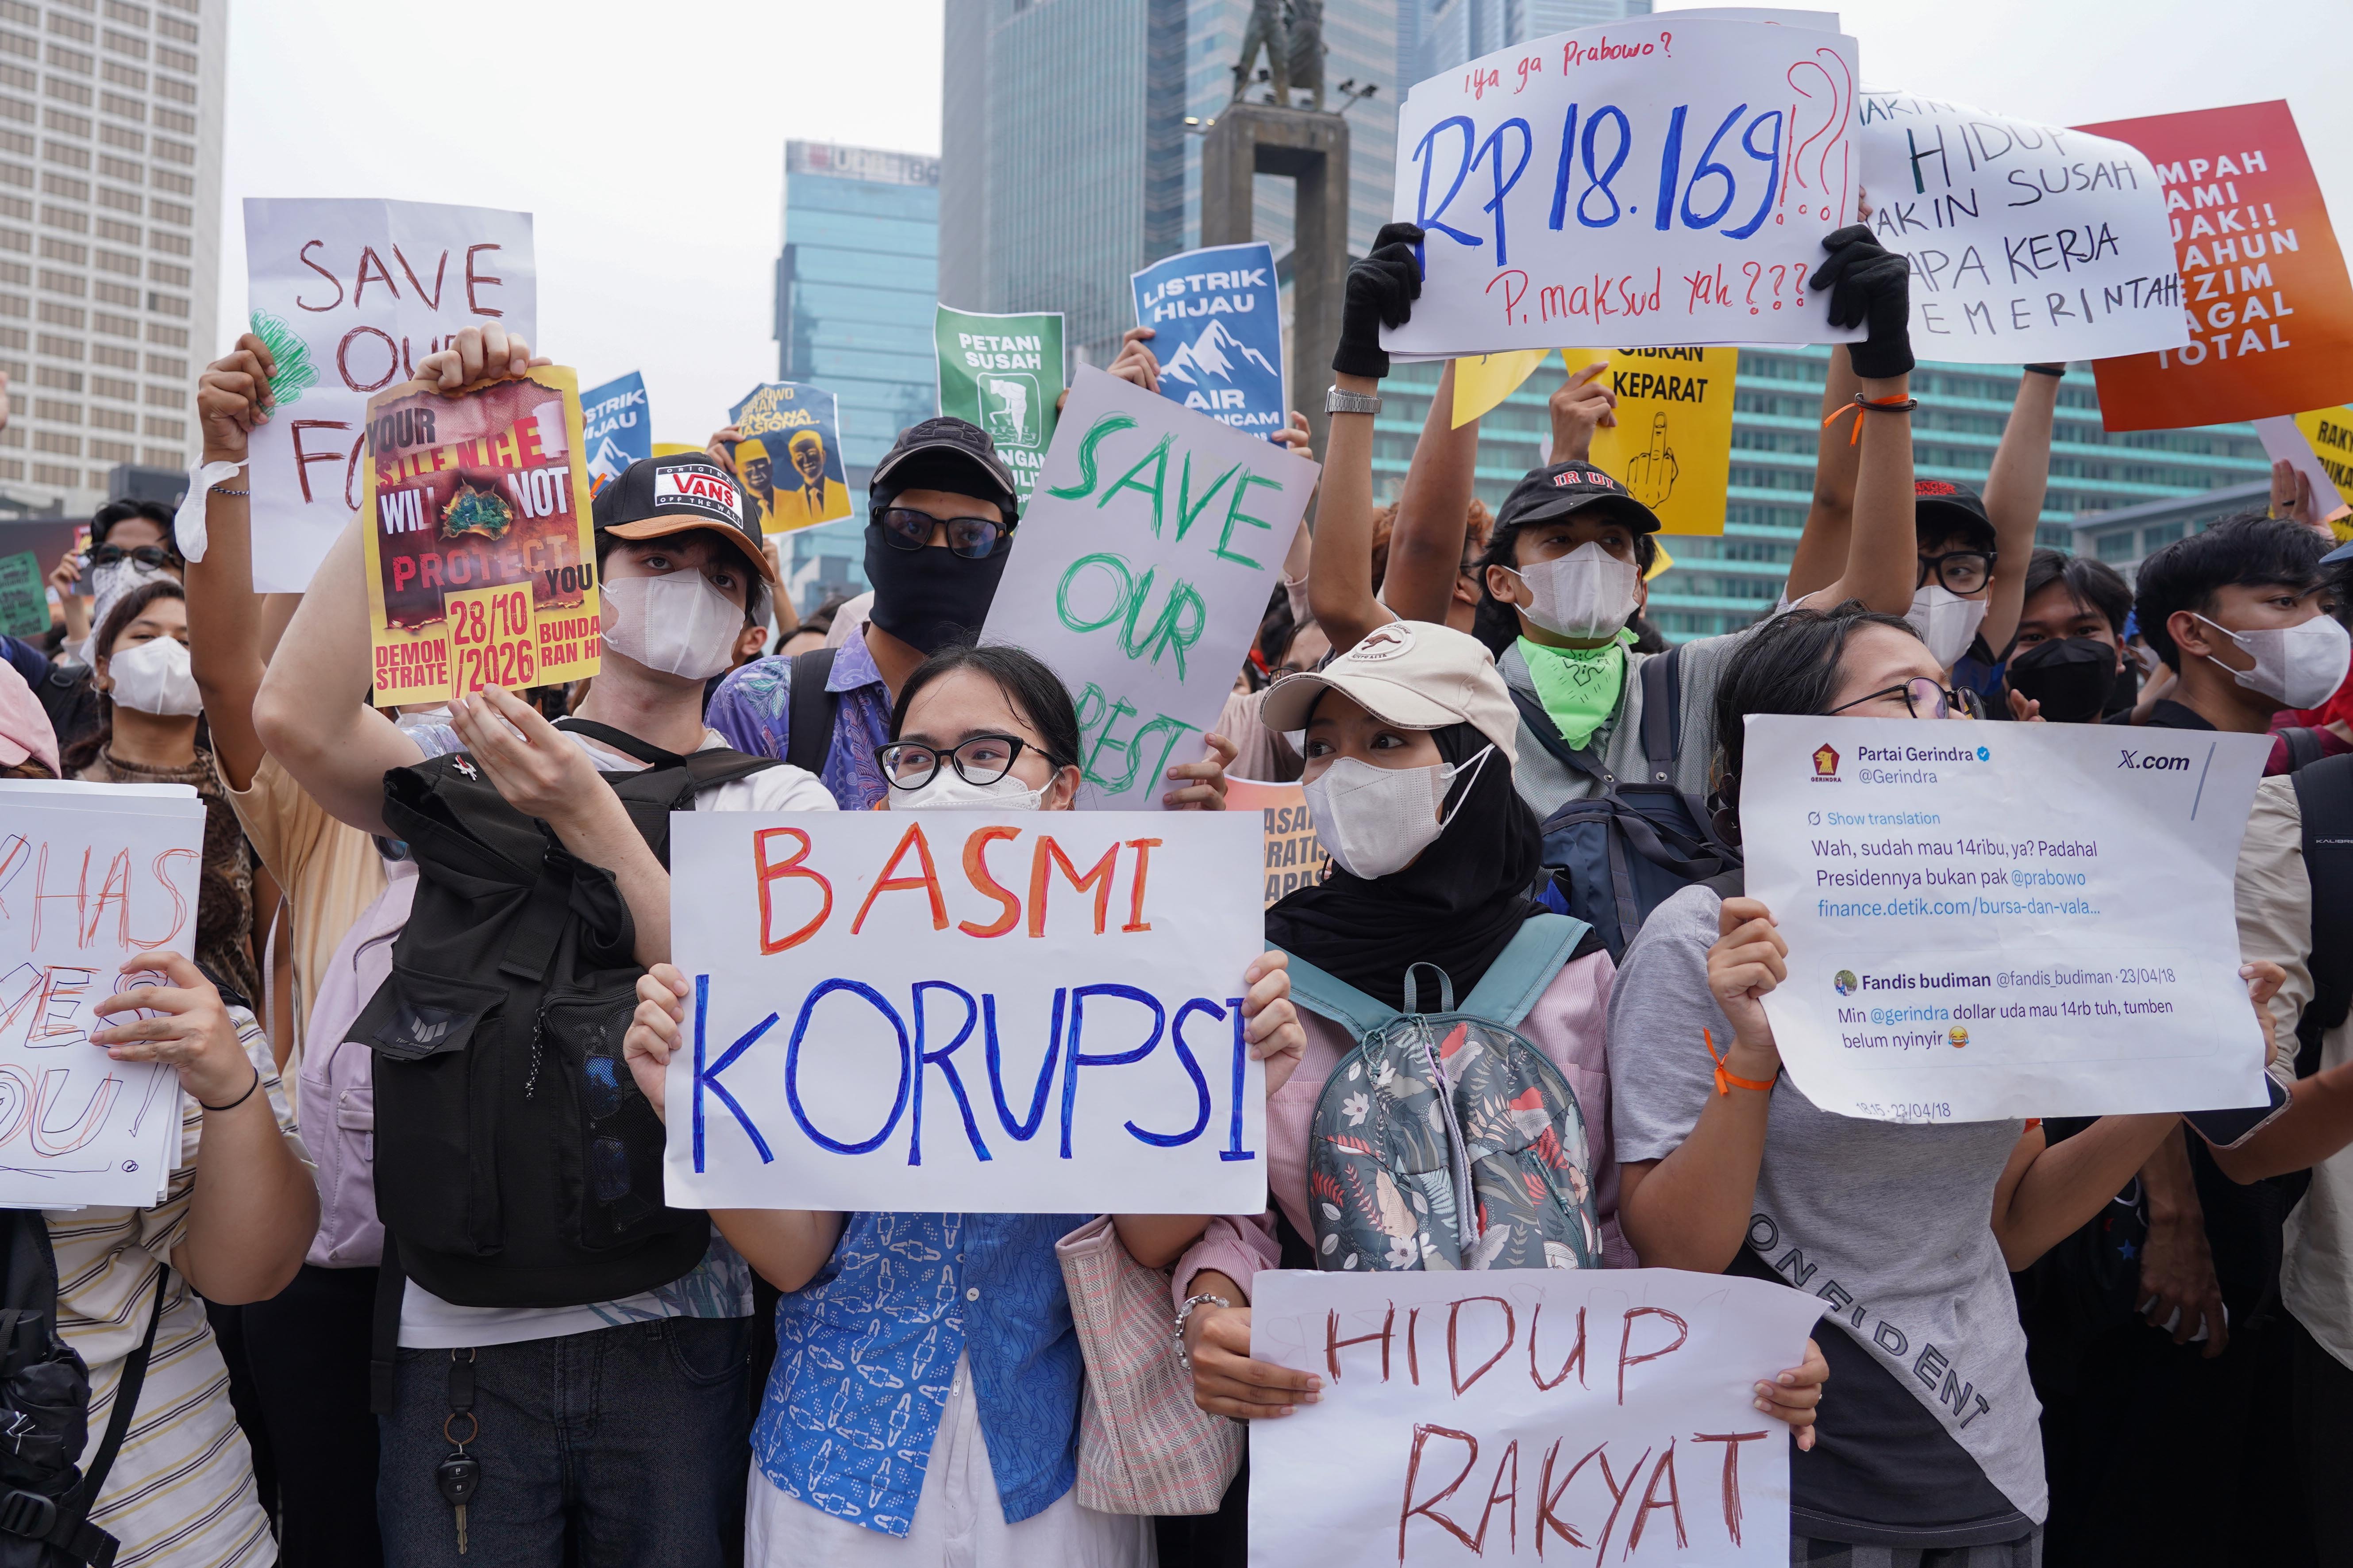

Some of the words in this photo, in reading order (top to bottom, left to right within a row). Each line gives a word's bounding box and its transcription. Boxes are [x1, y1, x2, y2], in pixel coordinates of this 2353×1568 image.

[1513, 57, 1541, 95] ga
[1906, 122, 2066, 194] HIDUP
[2007, 159, 2138, 208] SUSAH
[2004, 222, 2119, 284] KERJA
[2182, 228, 2299, 273] AHUN
[297, 239, 504, 318] SAVE
[1144, 268, 1268, 309] LISTRIK
[1154, 293, 1255, 323] HIJAU
[959, 332, 1041, 352] PETANI
[965, 351, 1041, 370] SUSAH
[1183, 388, 1246, 410] AIR
[1613, 371, 1709, 404] KEPARAT
[366, 408, 435, 457] YOUR
[379, 416, 546, 488] SILENCE
[507, 466, 569, 519] NOT
[666, 466, 735, 490] ORIGINAL
[673, 473, 733, 507] VANS
[1044, 411, 1284, 571] SAVE
[1553, 470, 1582, 487] IR
[689, 497, 711, 507] THE
[717, 504, 741, 524] WALL
[392, 534, 569, 592] PROTECT
[544, 563, 593, 596] YOU
[450, 591, 528, 650] 28/10
[539, 615, 600, 644] BUNDA
[1056, 552, 1206, 687] OUR
[375, 638, 447, 668] DEMON
[542, 643, 577, 667] RAN
[376, 661, 448, 690] STRATE
[1859, 746, 1902, 761] Partai
[1906, 747, 1974, 761] Gerindra
[2118, 750, 2190, 771] X.com
[1860, 769, 1938, 784] @Gerindra
[1828, 812, 1865, 825] Show
[1868, 812, 1941, 825] translation
[1811, 839, 1857, 859] Wah,
[1861, 838, 1913, 856] sudah
[1918, 842, 1953, 856] mau
[1956, 838, 2009, 858] 14ribu,
[2011, 840, 2034, 860] ya?
[2038, 840, 2098, 857] Padahal
[754, 821, 1163, 956] BASMI
[1817, 869, 1922, 890] Presidennya
[1926, 868, 1976, 885] bukan
[1981, 867, 2008, 888] pak
[2011, 869, 2086, 889] @prabowo
[1862, 974, 1916, 990] Fandis
[1920, 972, 1991, 988] budiman
[1996, 969, 2113, 988] @fandis_budiman
[2119, 968, 2176, 984] 23/04/18
[1838, 1007, 1866, 1023] Min
[1871, 1005, 1949, 1026] @gerindra
[1953, 1004, 1996, 1019] dollar
[2000, 1002, 2026, 1018] uda
[2029, 1004, 2057, 1017] mau
[2060, 1001, 2091, 1016] 14rb
[2094, 999, 2121, 1017] tuh,
[2123, 998, 2173, 1015] tumben
[1841, 1032, 1889, 1049] belum
[1892, 1030, 1943, 1051] nyinyir
[691, 973, 1255, 1173] KORUPSI
[1746, 1213, 1991, 1430] ONFIDENT
[1322, 1296, 1688, 1406] HIDUP
[1399, 1422, 1770, 1568] RAKYAT
